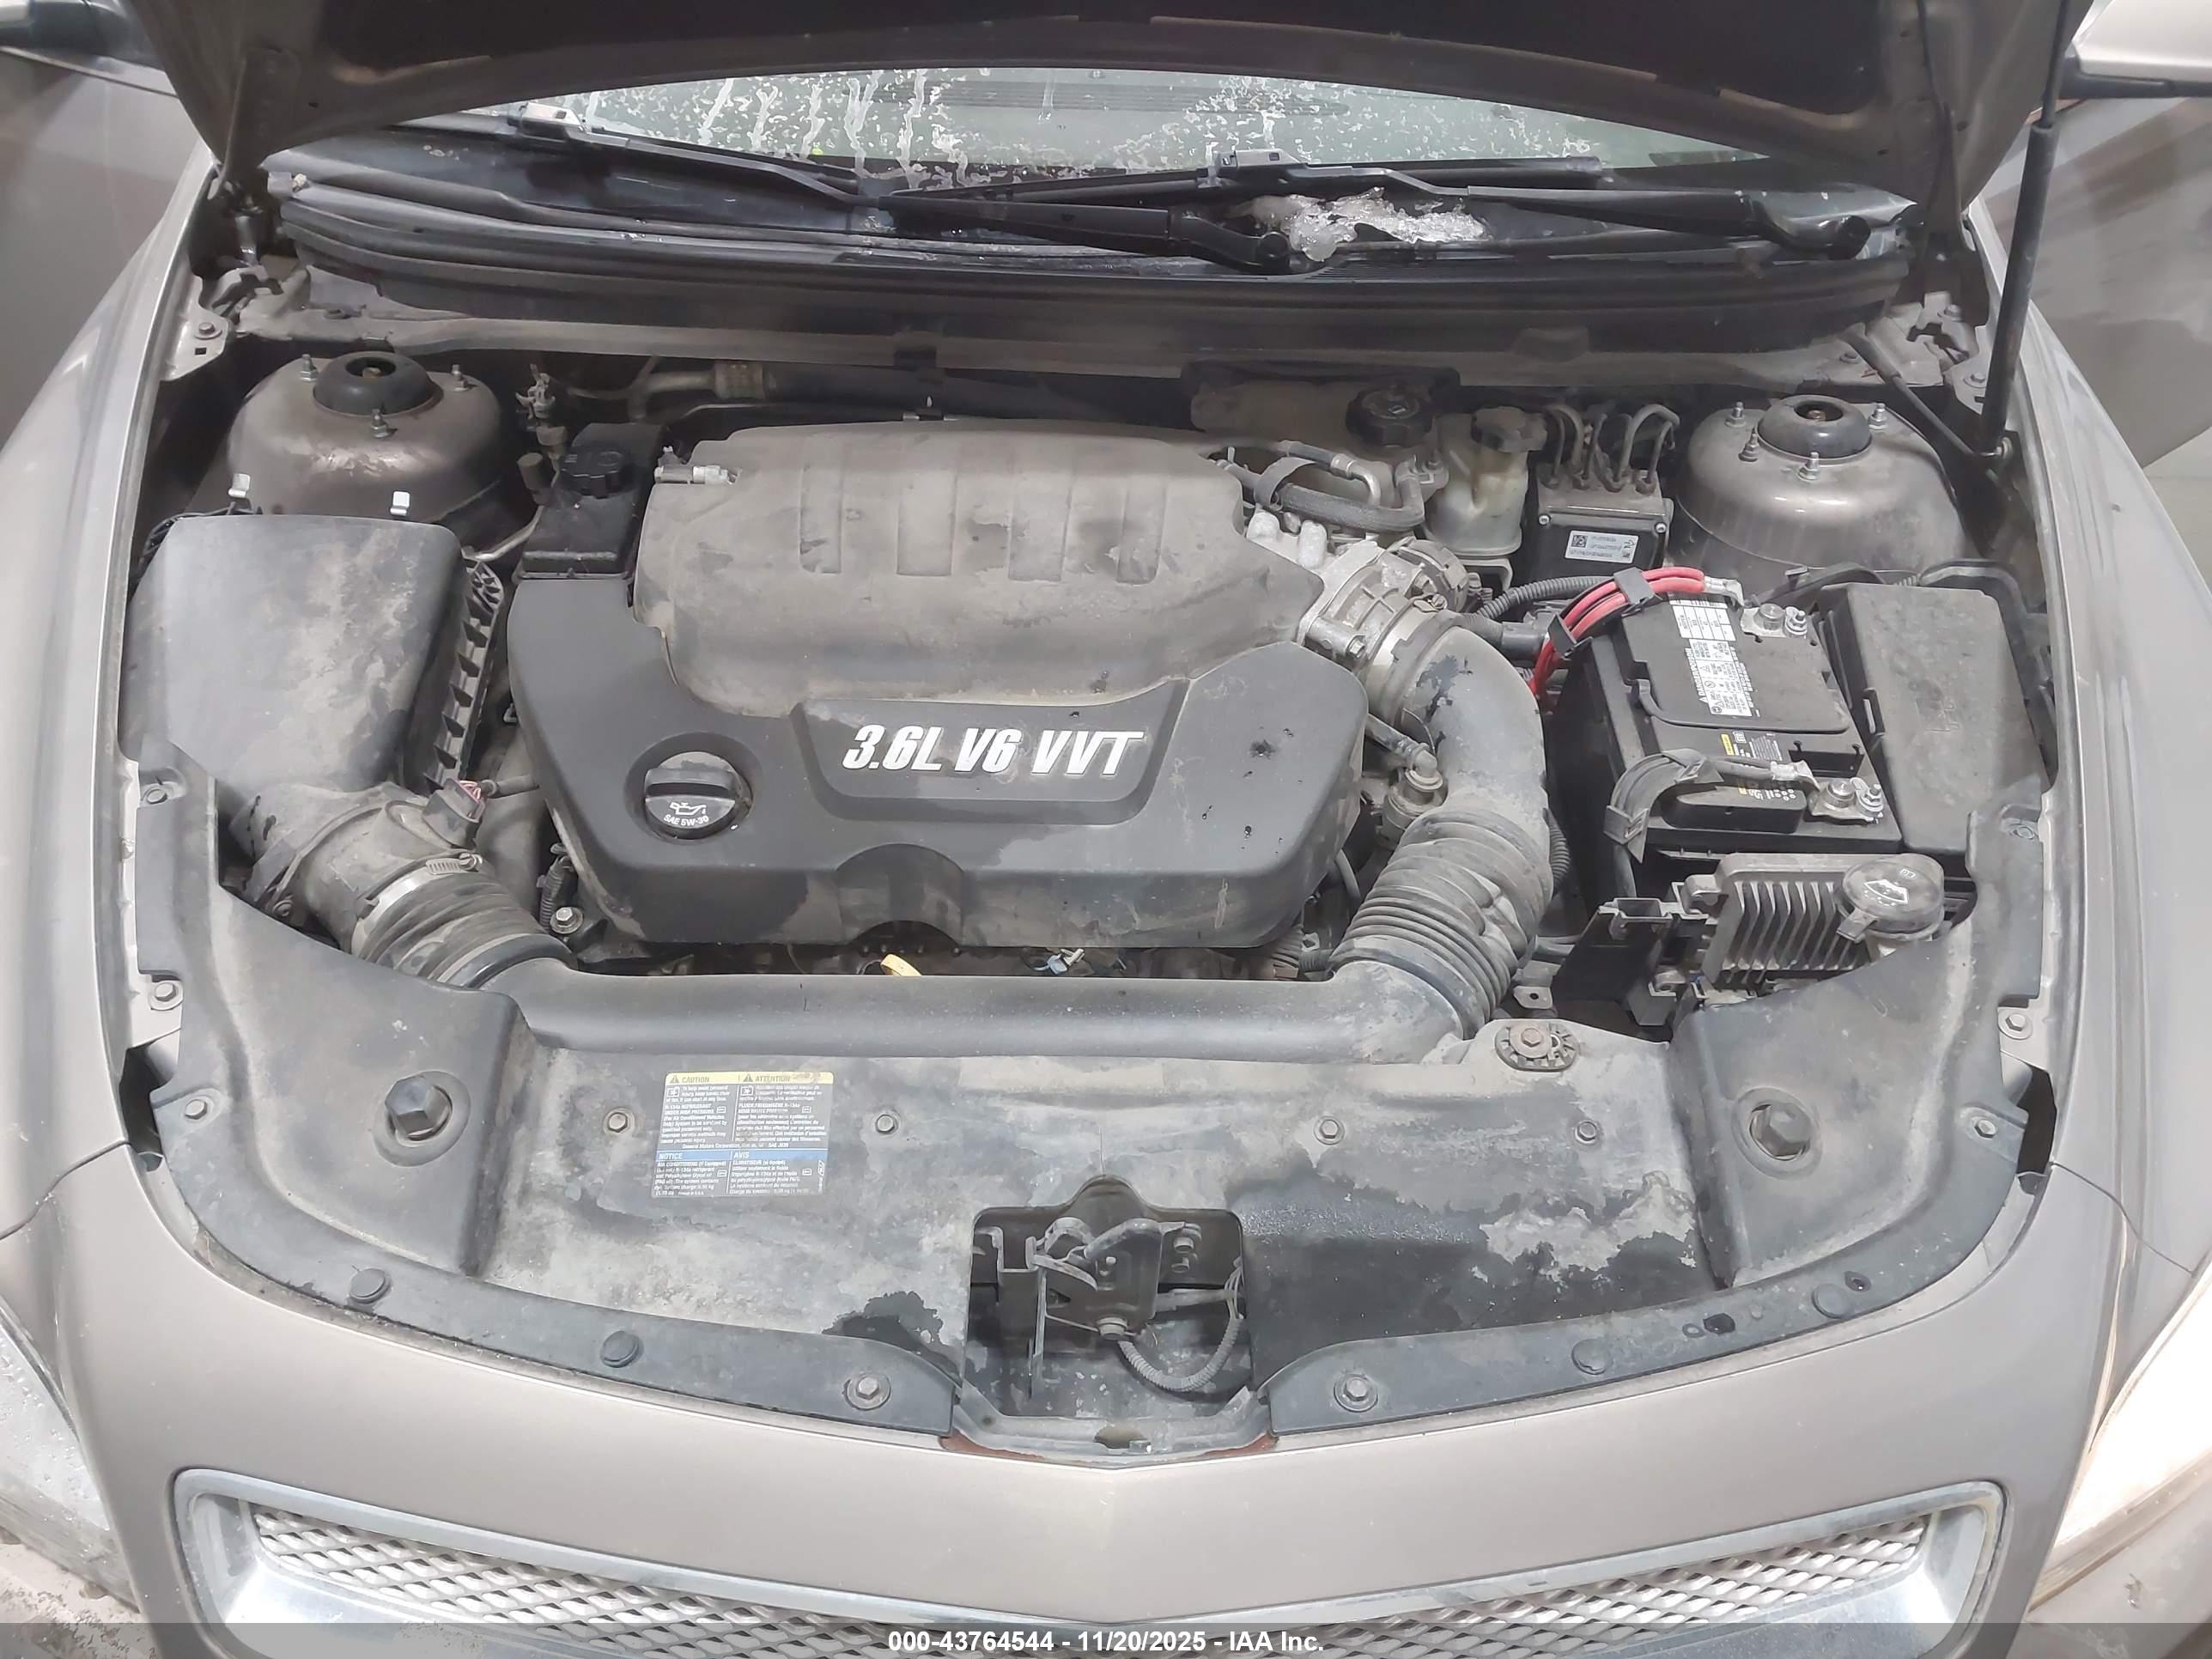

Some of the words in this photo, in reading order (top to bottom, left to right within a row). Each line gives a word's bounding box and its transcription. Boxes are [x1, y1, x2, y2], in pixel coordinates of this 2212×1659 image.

[842, 724, 942, 772] 3.6L
[953, 728, 1022, 774] V6
[1030, 730, 1146, 777] VVT
[663, 814, 680, 825] SAE
[681, 814, 709, 826] 5W-30
